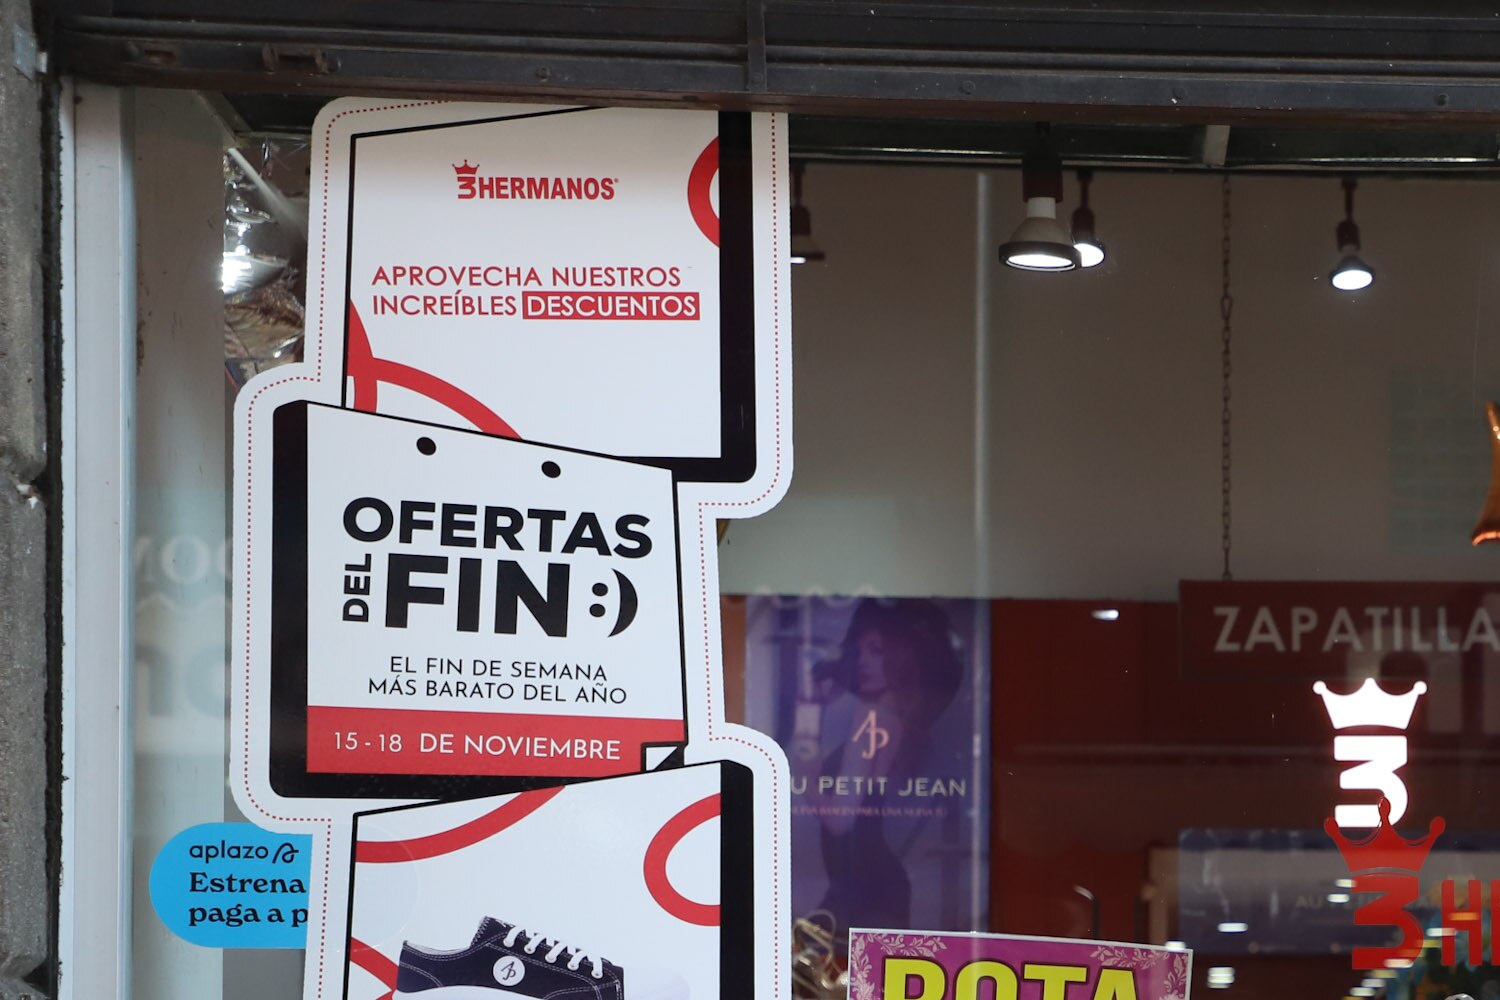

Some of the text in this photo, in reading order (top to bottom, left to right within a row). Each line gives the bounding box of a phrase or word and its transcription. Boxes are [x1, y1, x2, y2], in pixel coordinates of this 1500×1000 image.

[371, 265, 681, 288] APROVECHA NUESTROS
[372, 289, 697, 318] INCREÍBLES DESCUENTOS
[342, 496, 653, 559] OFERTAS
[342, 553, 371, 623] DEL
[384, 553, 571, 638] FIN
[389, 655, 607, 682] EL FIN DE SEMANA
[367, 670, 629, 705] MÁS BARATO DEL AÑO
[418, 732, 455, 755] DE
[463, 734, 622, 761] NOVIEMBRE
[817, 776, 889, 796] PETIT
[897, 776, 966, 797] JEAN
[189, 840, 270, 864] aplazo
[189, 871, 307, 894] Estrena
[188, 903, 261, 928] paga
[266, 907, 286, 923] a
